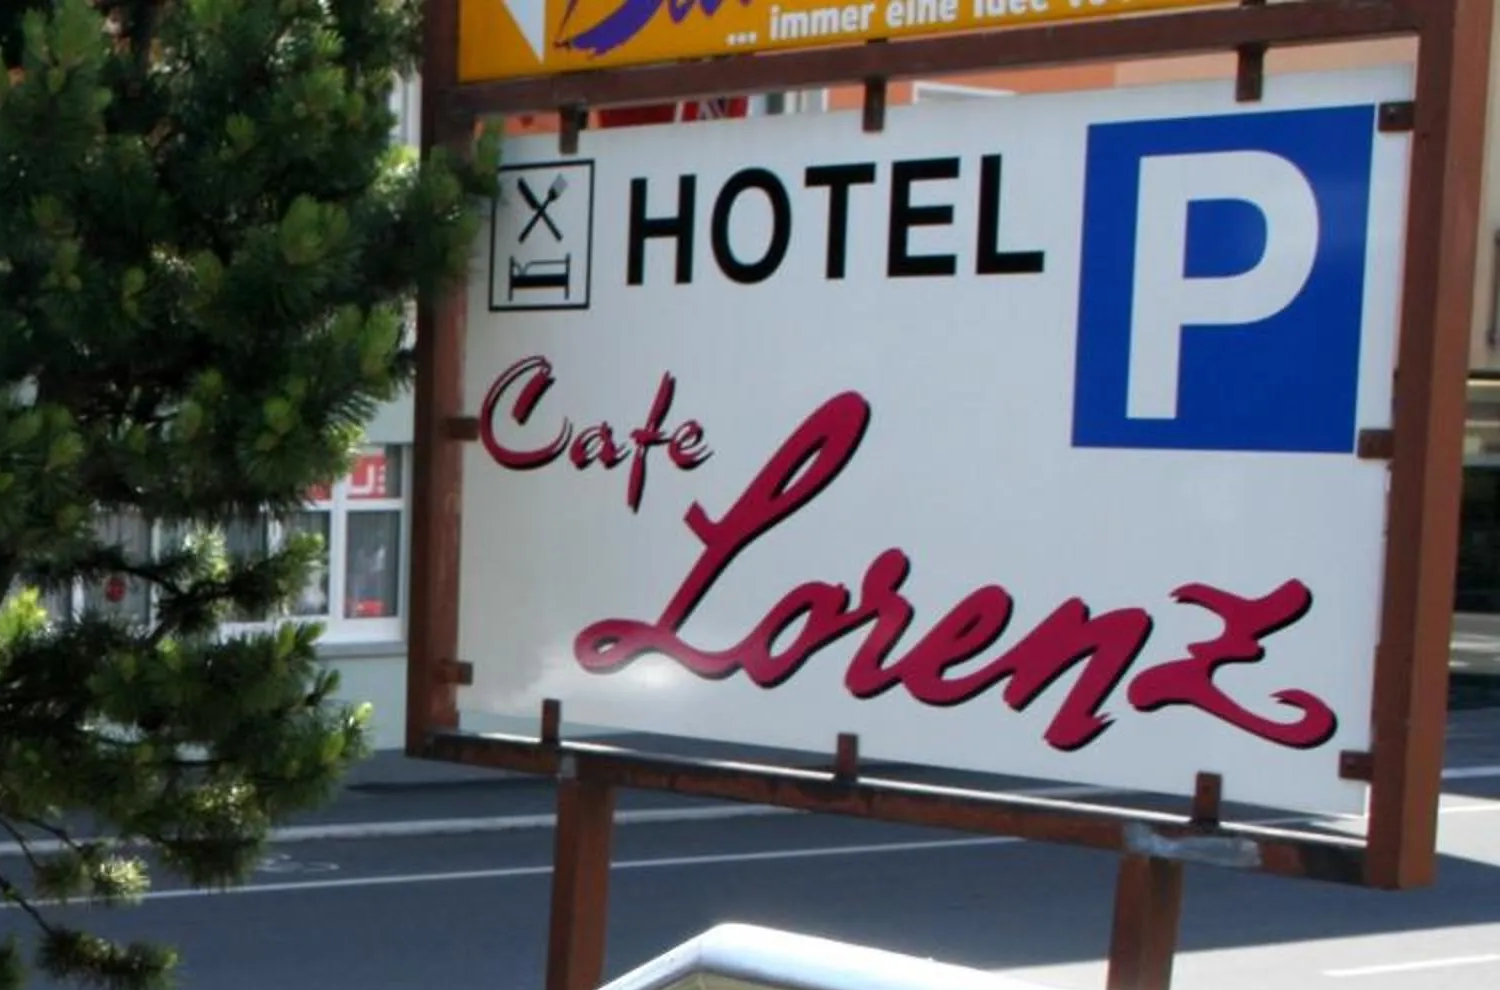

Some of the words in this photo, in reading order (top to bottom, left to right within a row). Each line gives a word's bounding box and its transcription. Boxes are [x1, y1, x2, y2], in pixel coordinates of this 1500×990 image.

[769, 4, 876, 41] immer
[885, 0, 958, 28] eine
[626, 154, 1044, 287] HOTEL
[1125, 149, 1320, 420] P
[477, 354, 712, 513] Cafe
[572, 390, 1337, 752] Lorenz
